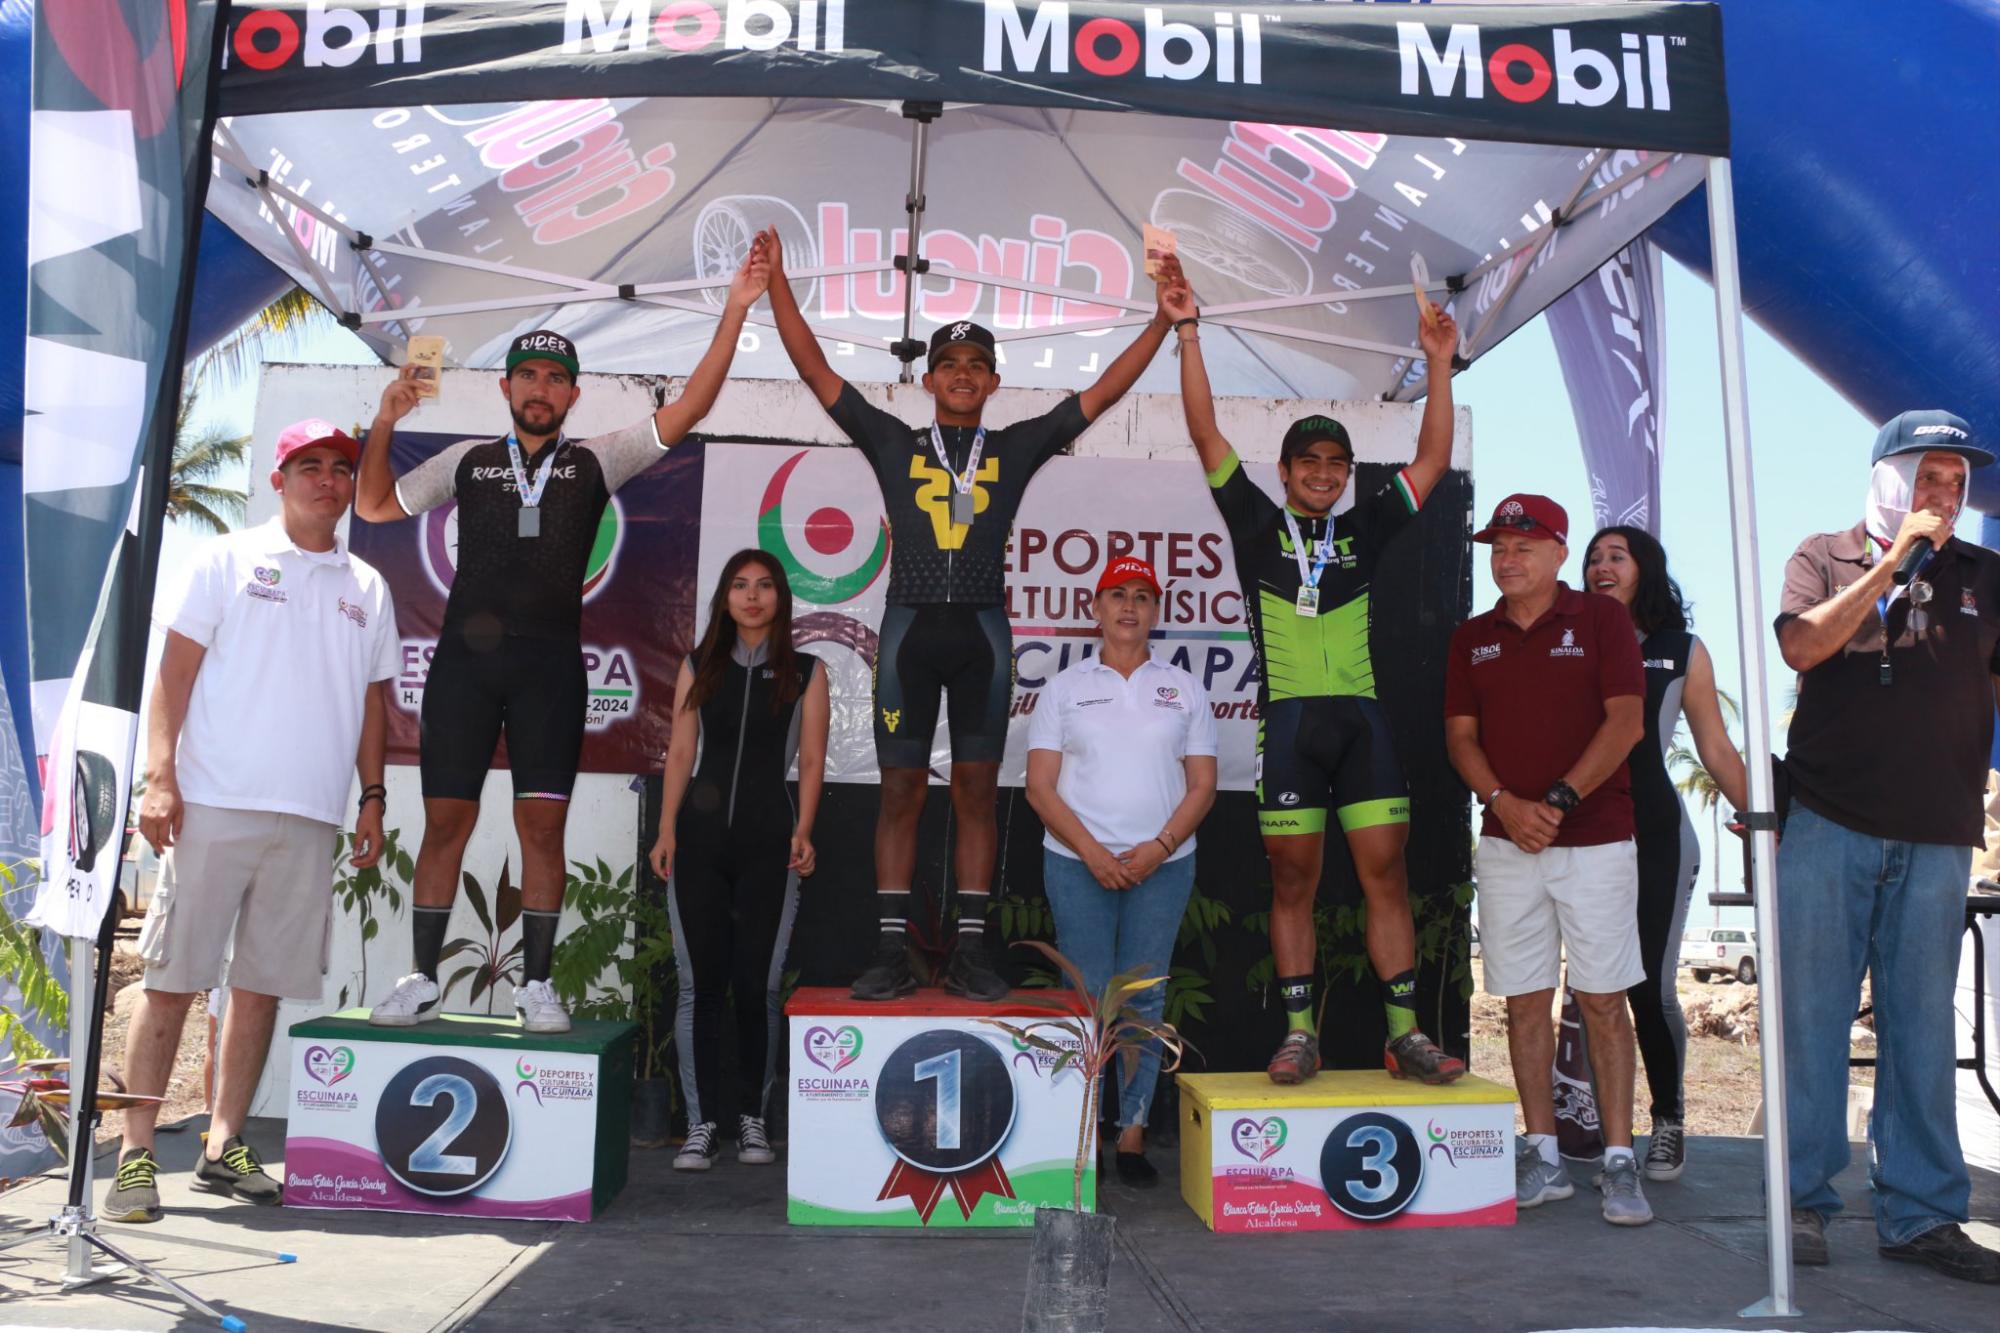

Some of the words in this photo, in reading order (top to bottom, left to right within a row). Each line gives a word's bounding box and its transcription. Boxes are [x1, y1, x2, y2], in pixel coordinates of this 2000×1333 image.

[561, 0, 845, 54] Mobil
[221, 0, 424, 71] obil
[983, 0, 1262, 84] Mobil
[1396, 21, 1671, 111] Mobil
[520, 335, 567, 355] RIDER
[1913, 425, 1968, 440] GIANT
[532, 465, 576, 481] BKE
[1005, 586, 1093, 620] LTUR
[404, 691, 418, 704] H.
[540, 1070, 584, 1080] DEPORTES
[798, 1079, 869, 1089] ESCUINAPA
[297, 1090, 358, 1102] ESCUINAPA
[541, 1087, 593, 1097] ESCUINAPA
[914, 1049, 961, 1149] 1
[408, 1074, 477, 1176] 2
[1450, 1130, 1495, 1139] DEPORTES
[1453, 1146, 1504, 1155] ESCUINAPA
[1345, 1125, 1399, 1202] 3
[1226, 1167, 1294, 1177] ESCUINAPA
[310, 1191, 362, 1202] Alcaldesa
[1246, 1218, 1298, 1228] Alcaldesa
